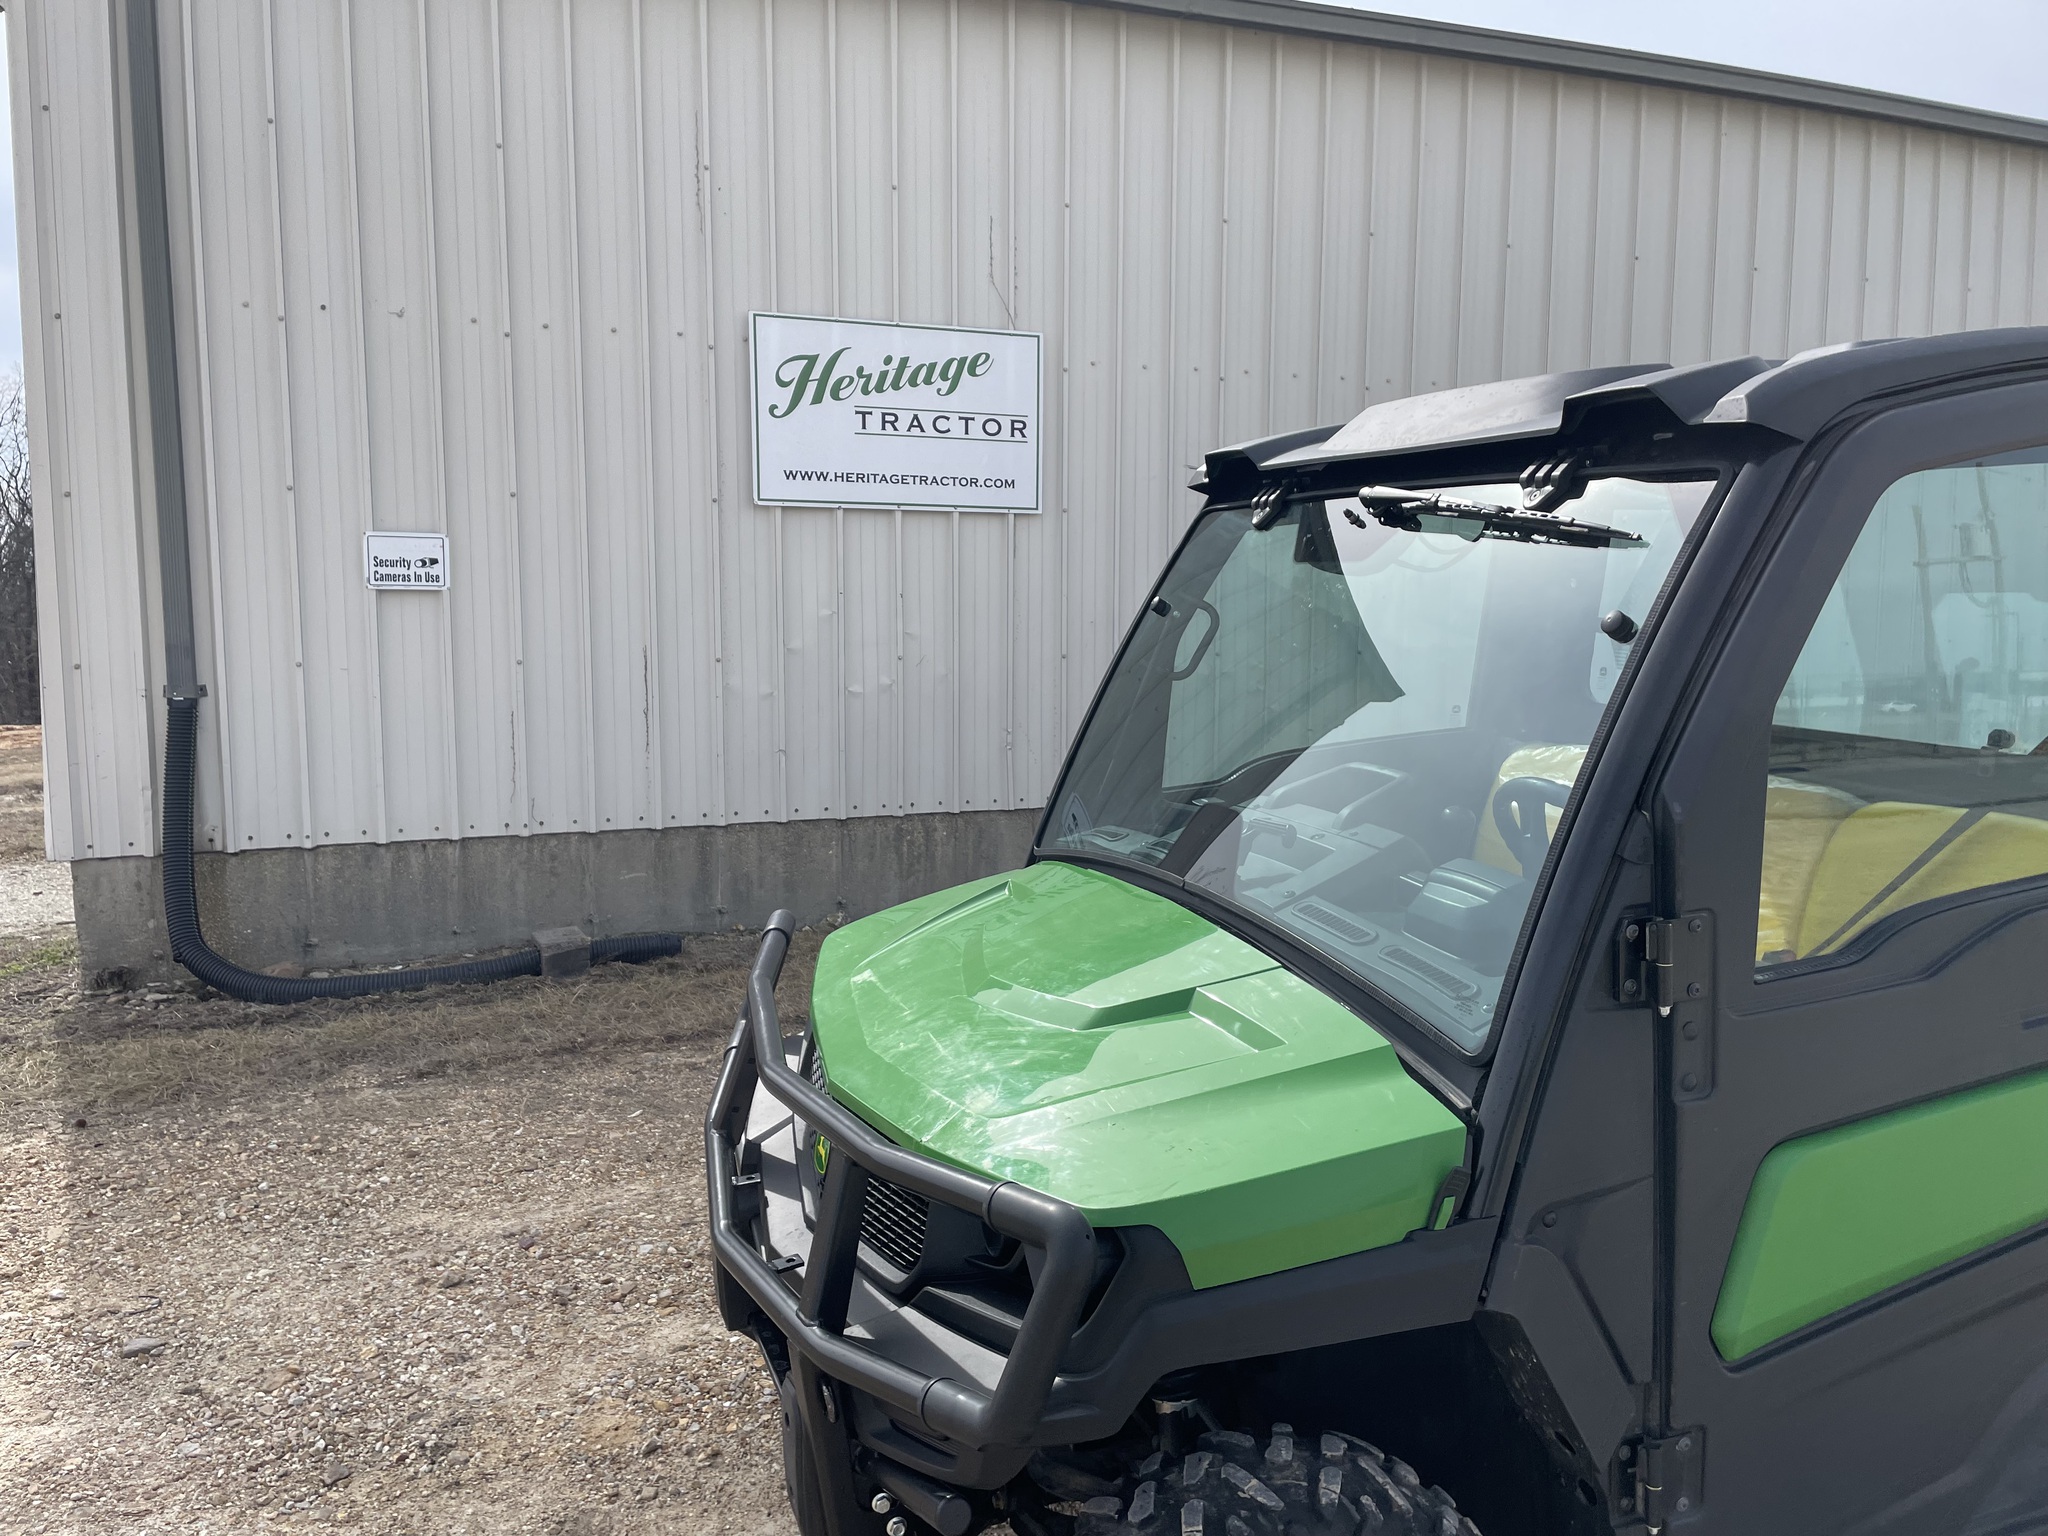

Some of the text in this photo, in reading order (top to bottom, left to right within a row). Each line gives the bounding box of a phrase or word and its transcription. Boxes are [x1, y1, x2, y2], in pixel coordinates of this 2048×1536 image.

[768, 346, 994, 418] Heritage
[855, 410, 1028, 438] TRACTOR
[783, 469, 1016, 489] WWW.HERITAGETRACTOR.COM
[373, 555, 411, 570] Security
[373, 570, 440, 583] Cameras In Use
